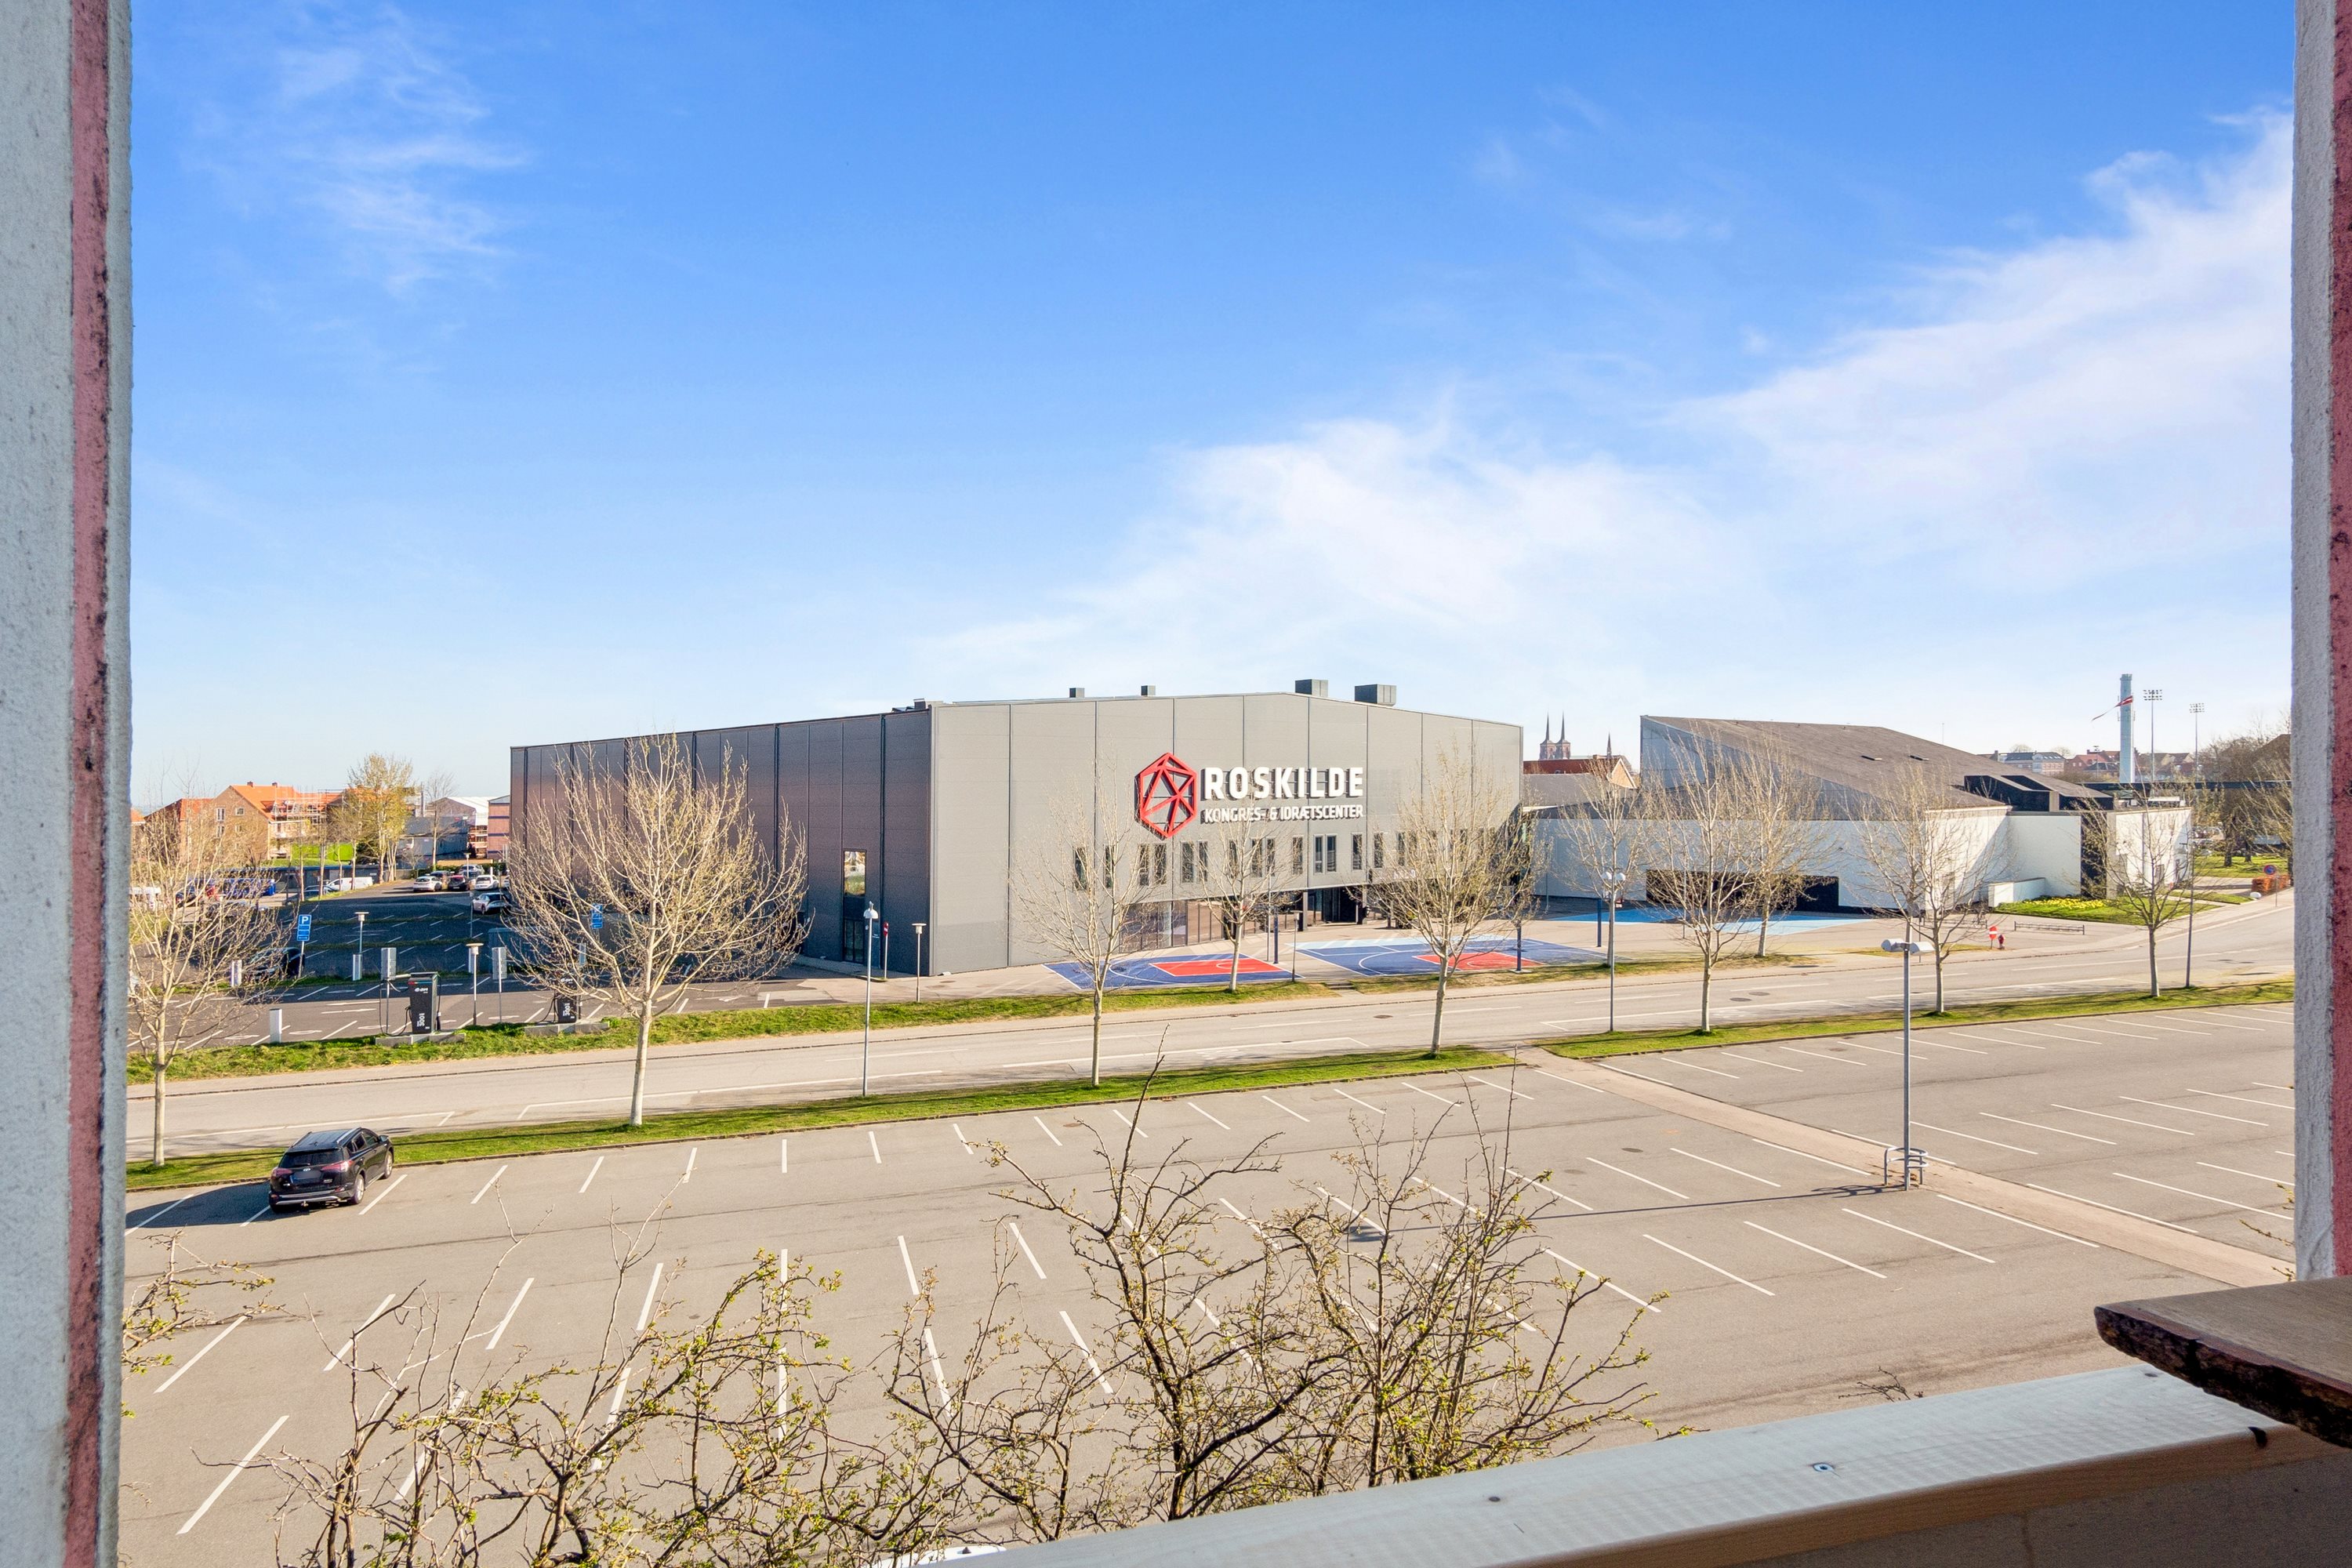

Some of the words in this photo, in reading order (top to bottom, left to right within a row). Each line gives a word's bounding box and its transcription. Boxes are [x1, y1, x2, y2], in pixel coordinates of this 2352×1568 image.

[1204, 766, 1363, 800] ROSKILDE
[1205, 807, 1266, 823] KONGRES-
[1270, 806, 1278, 821] &
[1279, 804, 1364, 820] IDRÆTSCENTER
[302, 916, 309, 924] P
